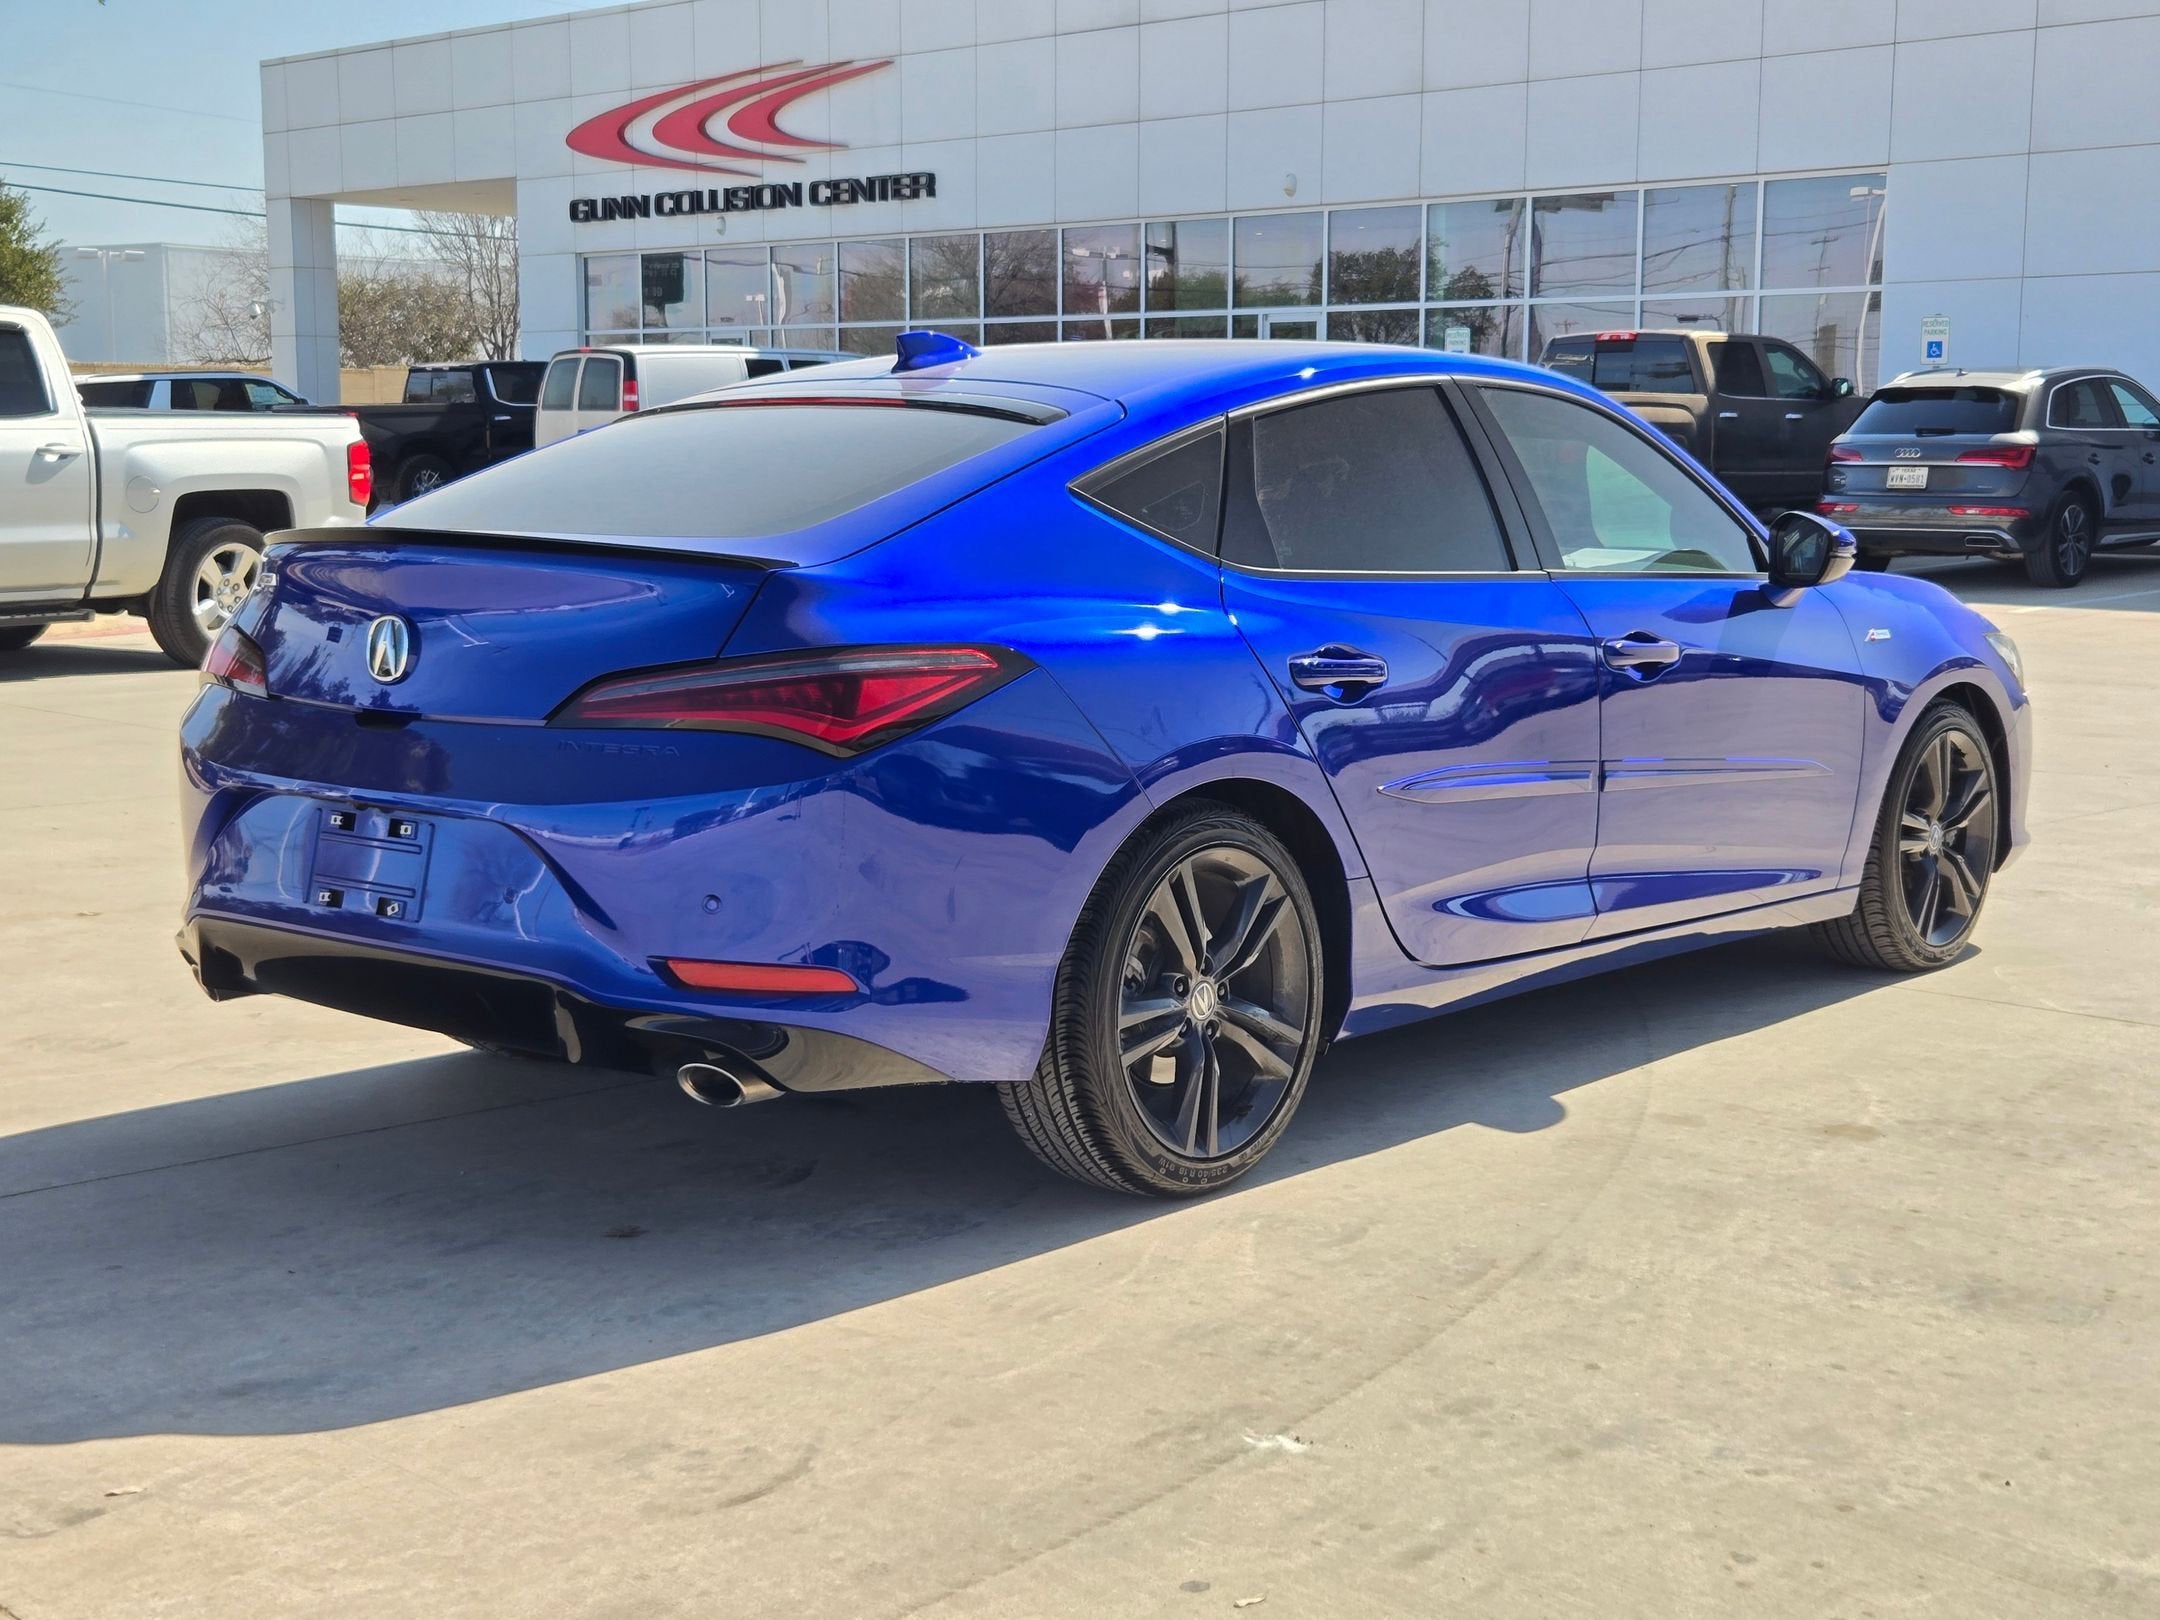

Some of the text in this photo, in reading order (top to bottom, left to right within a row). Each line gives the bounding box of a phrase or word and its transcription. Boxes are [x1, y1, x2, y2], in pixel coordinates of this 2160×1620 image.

[570, 172, 936, 223] GUNN COLLISION CENTER
[1924, 328, 1947, 336] PARKING
[558, 740, 680, 757] INTEGRA
